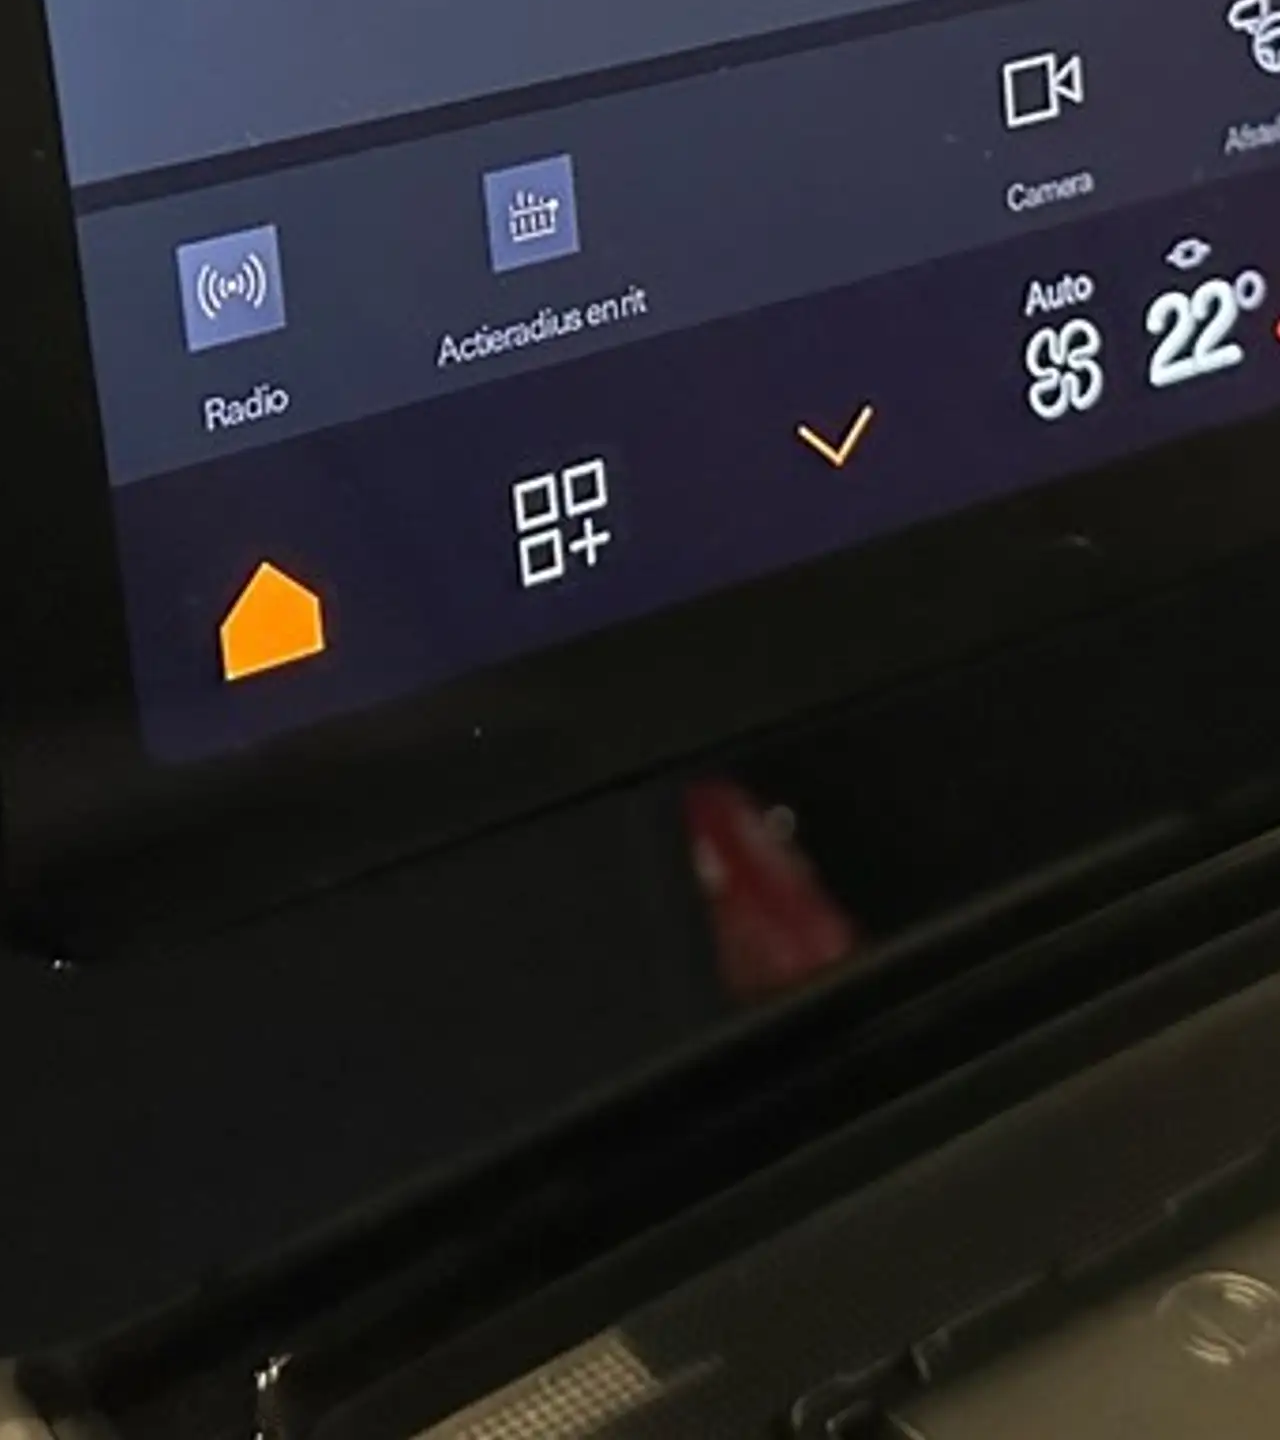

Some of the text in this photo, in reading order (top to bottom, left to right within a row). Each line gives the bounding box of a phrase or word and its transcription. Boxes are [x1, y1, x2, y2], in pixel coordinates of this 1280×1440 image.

[1006, 170, 1095, 213] Camera
[1025, 273, 1094, 316] Auto
[437, 284, 648, 367] Actieradius en rit
[203, 384, 290, 432] Radio
